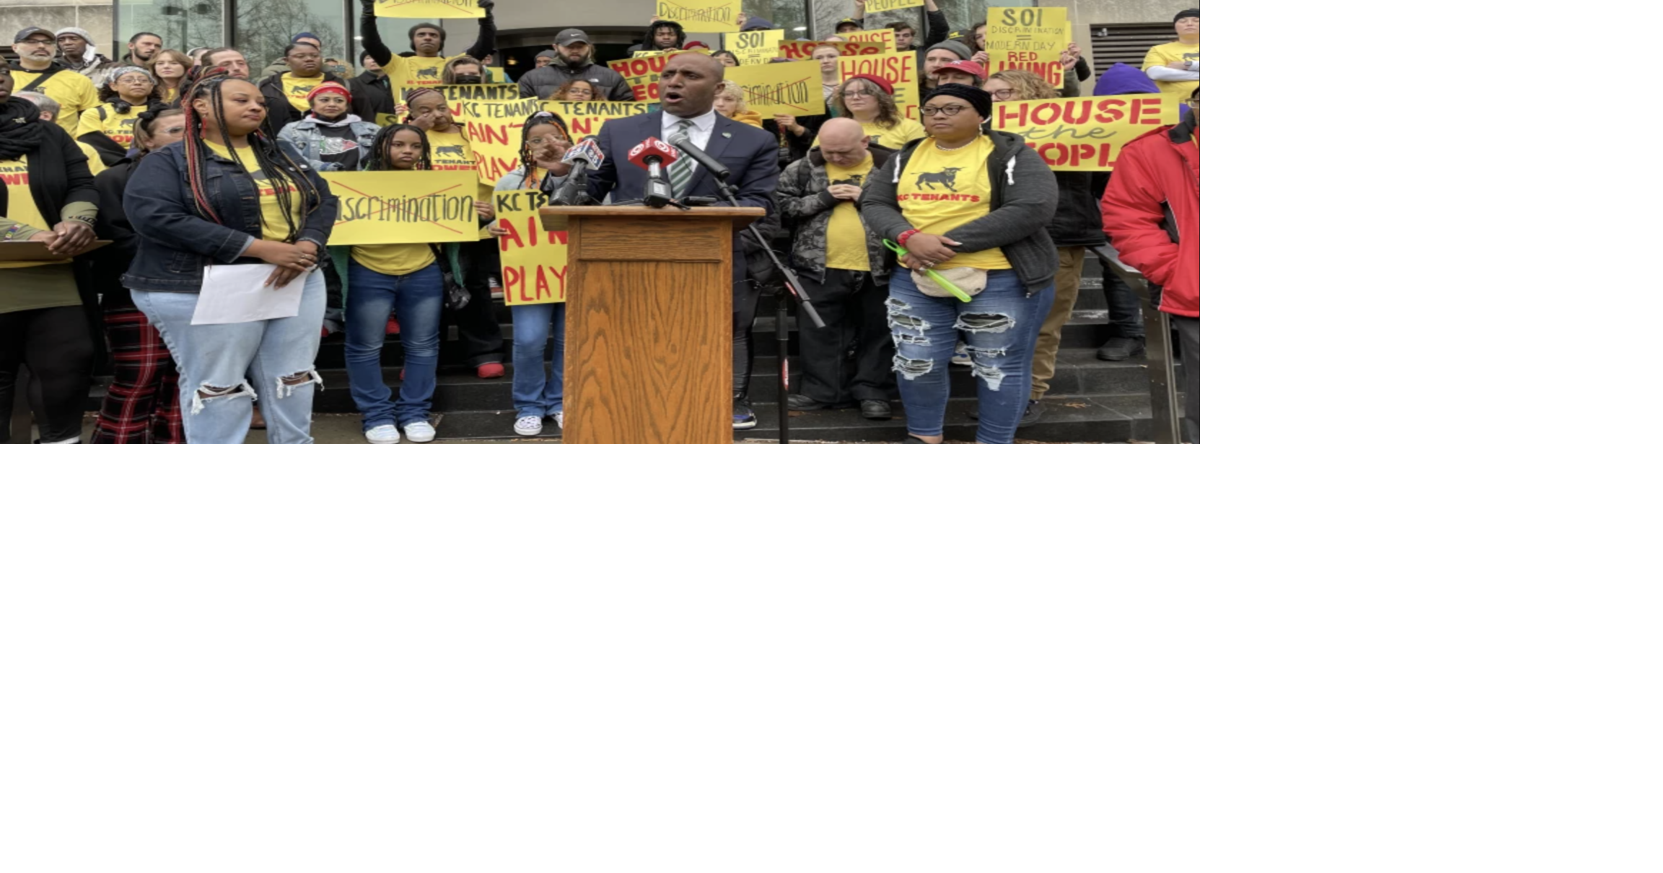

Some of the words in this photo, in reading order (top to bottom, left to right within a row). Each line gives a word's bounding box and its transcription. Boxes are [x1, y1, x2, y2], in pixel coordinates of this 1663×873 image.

[1002, 8, 1042, 27] SOI
[736, 32, 765, 49] SOI
[986, 41, 1031, 50] MODERN
[1034, 41, 1056, 51] DAY
[611, 54, 678, 77] HOU
[1008, 51, 1038, 61] RED
[841, 56, 912, 84] HOUSE
[434, 85, 518, 101] TENANTS
[463, 101, 481, 118] KC
[483, 99, 539, 119] TENANTS
[559, 101, 645, 116] TENANTS
[998, 98, 1162, 129] HOUSE
[1017, 124, 1117, 140] the
[1025, 142, 1118, 168] OPL
[496, 193, 522, 213] KC
[911, 192, 980, 203] TENANTS
[336, 194, 474, 223] iscrimination
[503, 264, 568, 303] PLAY
